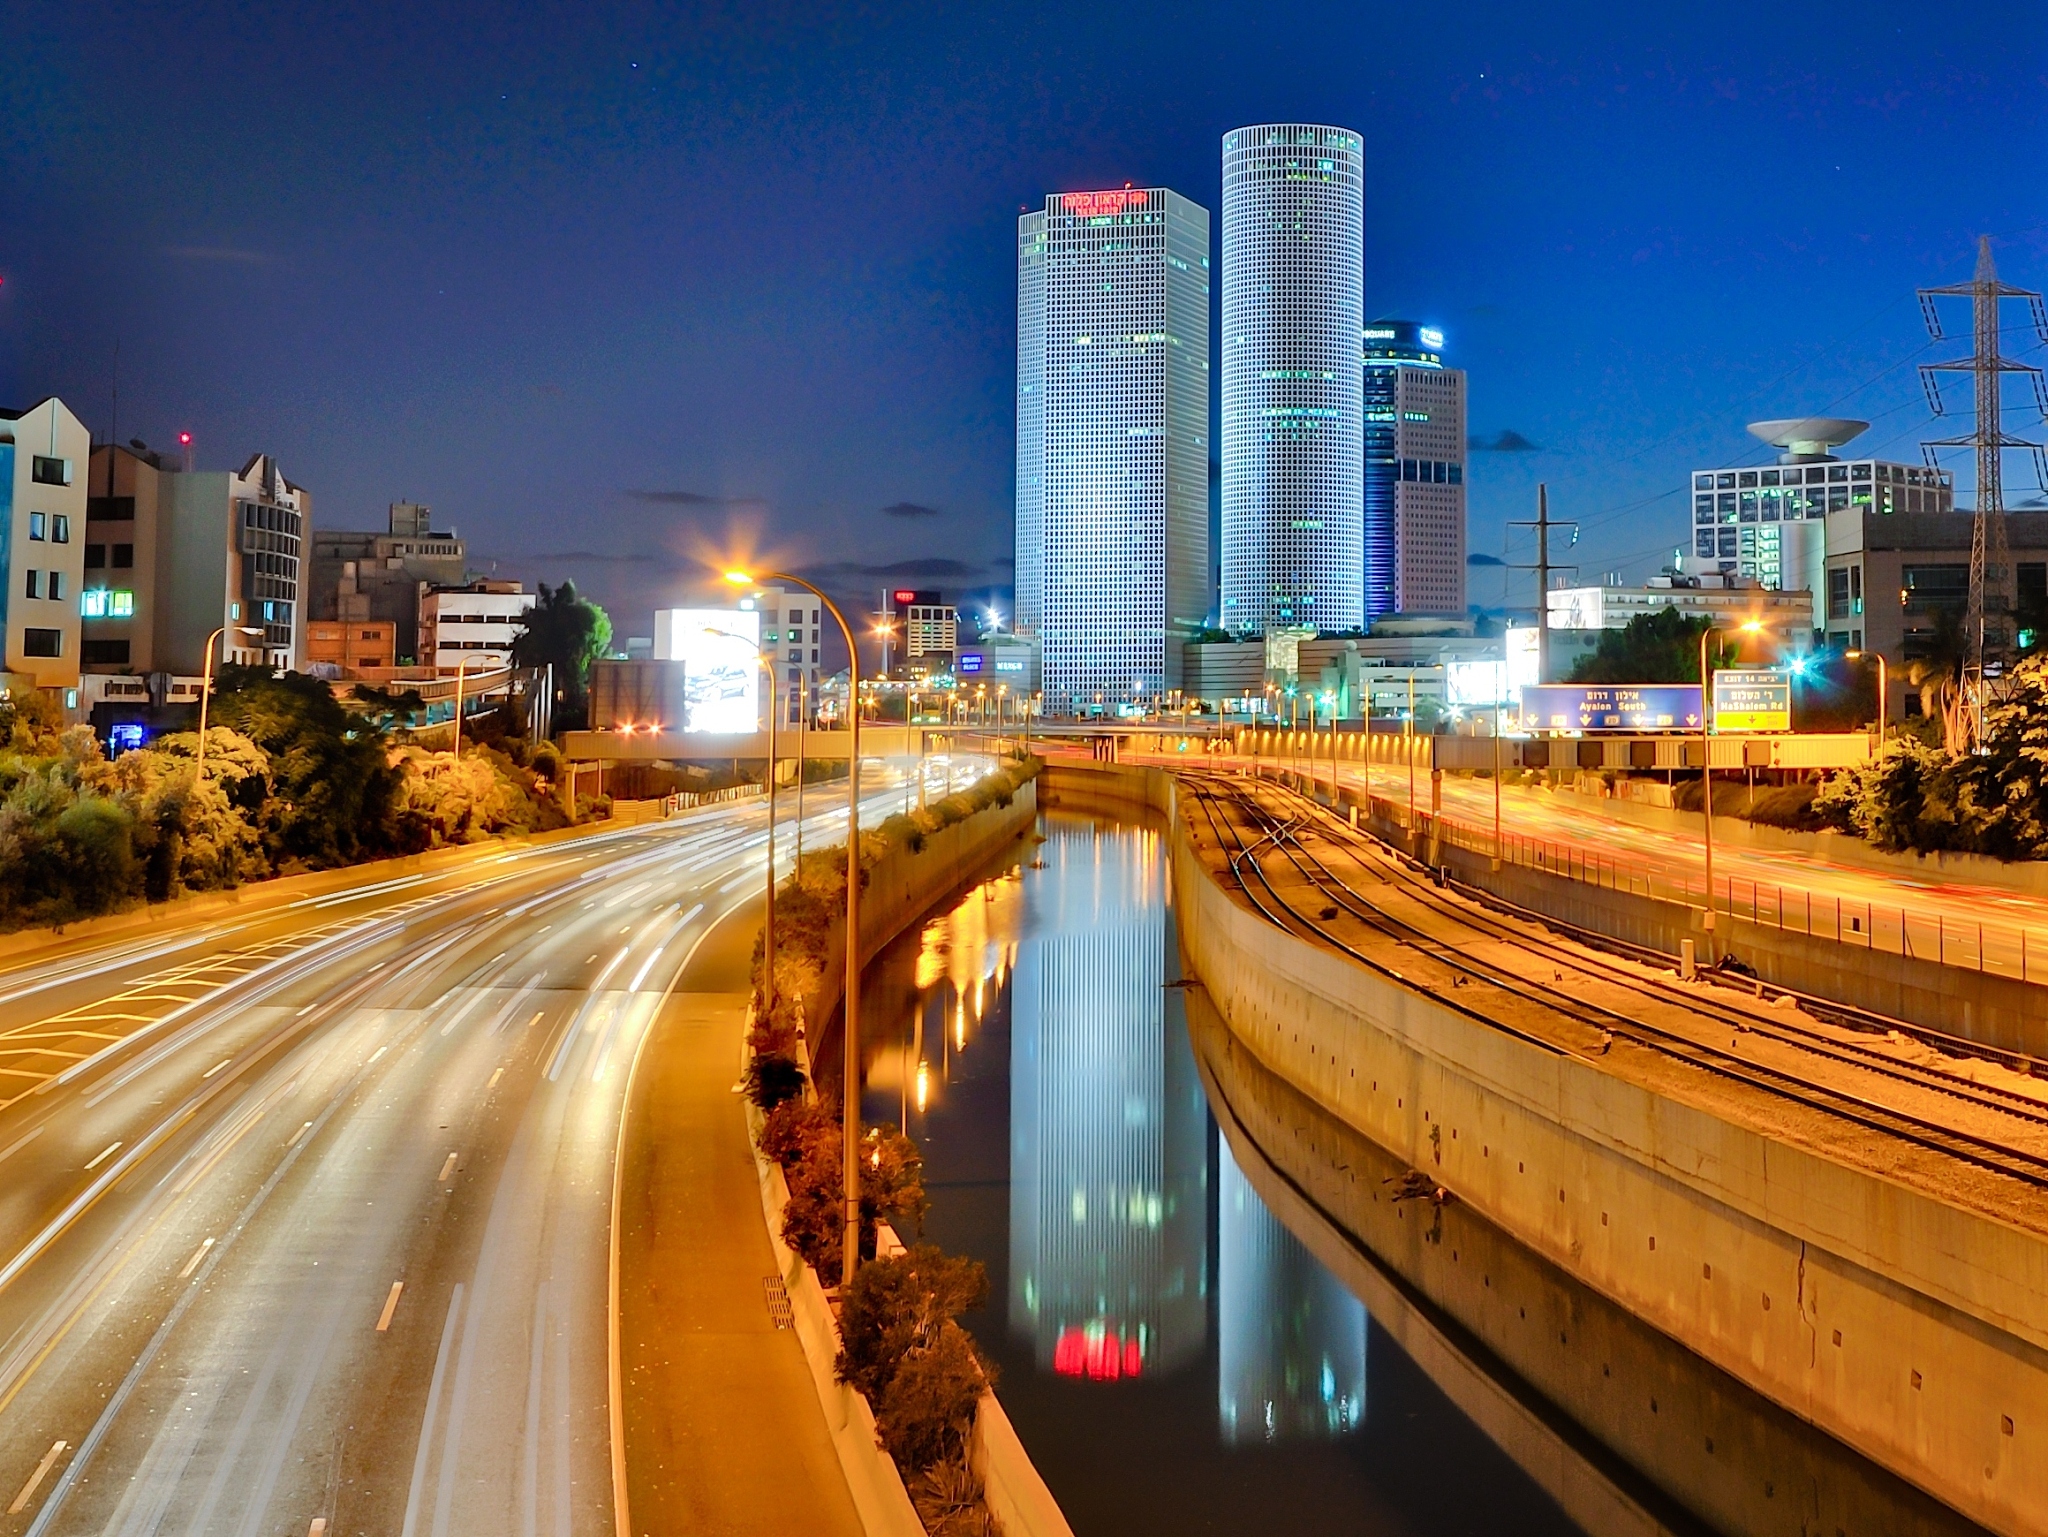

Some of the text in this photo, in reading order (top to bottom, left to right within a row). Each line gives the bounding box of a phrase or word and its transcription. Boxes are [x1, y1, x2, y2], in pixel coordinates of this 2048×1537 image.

[1586, 691, 1639, 701] אילון דרום
[1731, 689, 1760, 700] השלום
[1579, 702, 1647, 712] Ayalon South
[1720, 701, 1783, 710] HaShalom Rd
